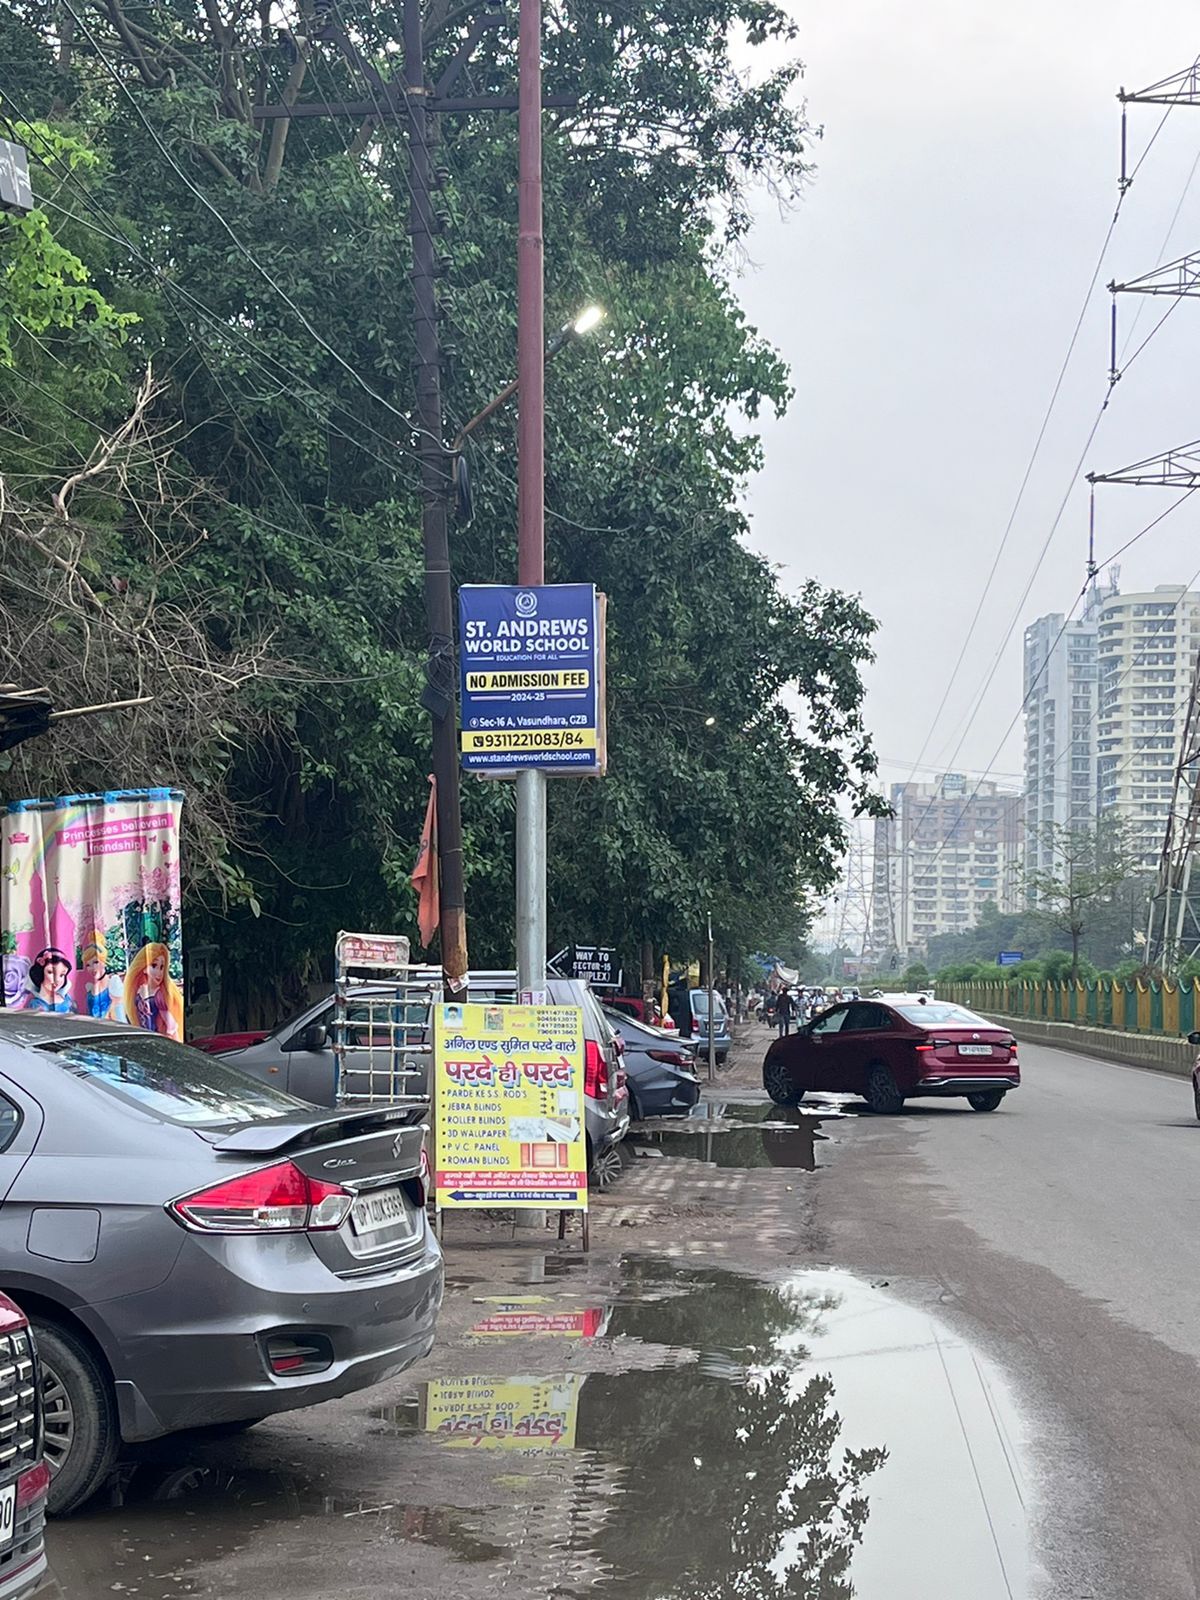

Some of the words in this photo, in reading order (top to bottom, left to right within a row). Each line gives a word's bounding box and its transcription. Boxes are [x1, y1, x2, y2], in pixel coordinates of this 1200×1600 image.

[465, 620, 492, 638] ST.
[496, 618, 588, 637] ANDREWS
[464, 639, 522, 653] WORLD
[525, 637, 590, 652] SCHOOL
[496, 654, 533, 662] EDUCATION
[469, 674, 487, 688] NO
[490, 673, 559, 688] ADMISSION
[563, 672, 586, 686] FEE
[511, 692, 546, 701] 2024-25
[480, 717, 506, 727] Sec-16
[506, 717, 516, 728] A,
[516, 715, 569, 727] Vasundhara,
[569, 715, 588, 725] GZB
[485, 731, 584, 748] 9311221083/84
[468, 751, 591, 763] www.standrewsworldschool.com
[575, 951, 594, 961] WAY
[597, 951, 610, 962] TO
[572, 961, 612, 971] SECTOR-15
[444, 1035, 475, 1050] अनिल
[477, 1039, 498, 1051] एण्ड
[500, 1036, 529, 1054] सुमित
[532, 1038, 553, 1051] परदे
[555, 1038, 576, 1052] वाले
[444, 1054, 496, 1084] परदे
[498, 1061, 519, 1085] ही
[522, 1055, 572, 1085] परदे
[447, 1089, 473, 1098] PARDE
[475, 1089, 485, 1098] KE
[447, 1102, 472, 1111] JEBRA
[474, 1103, 502, 1112] BLINDS
[447, 1115, 476, 1124] ROLLER
[478, 1116, 506, 1125] BLINDS
[447, 1129, 459, 1138] 3D
[460, 1129, 507, 1138] WALLPAPER
[474, 1142, 500, 1152] PANEL
[447, 1156, 480, 1165] ROMAN
[482, 1156, 510, 1165] BLINDS
[0, 1496, 12, 1530] 0
